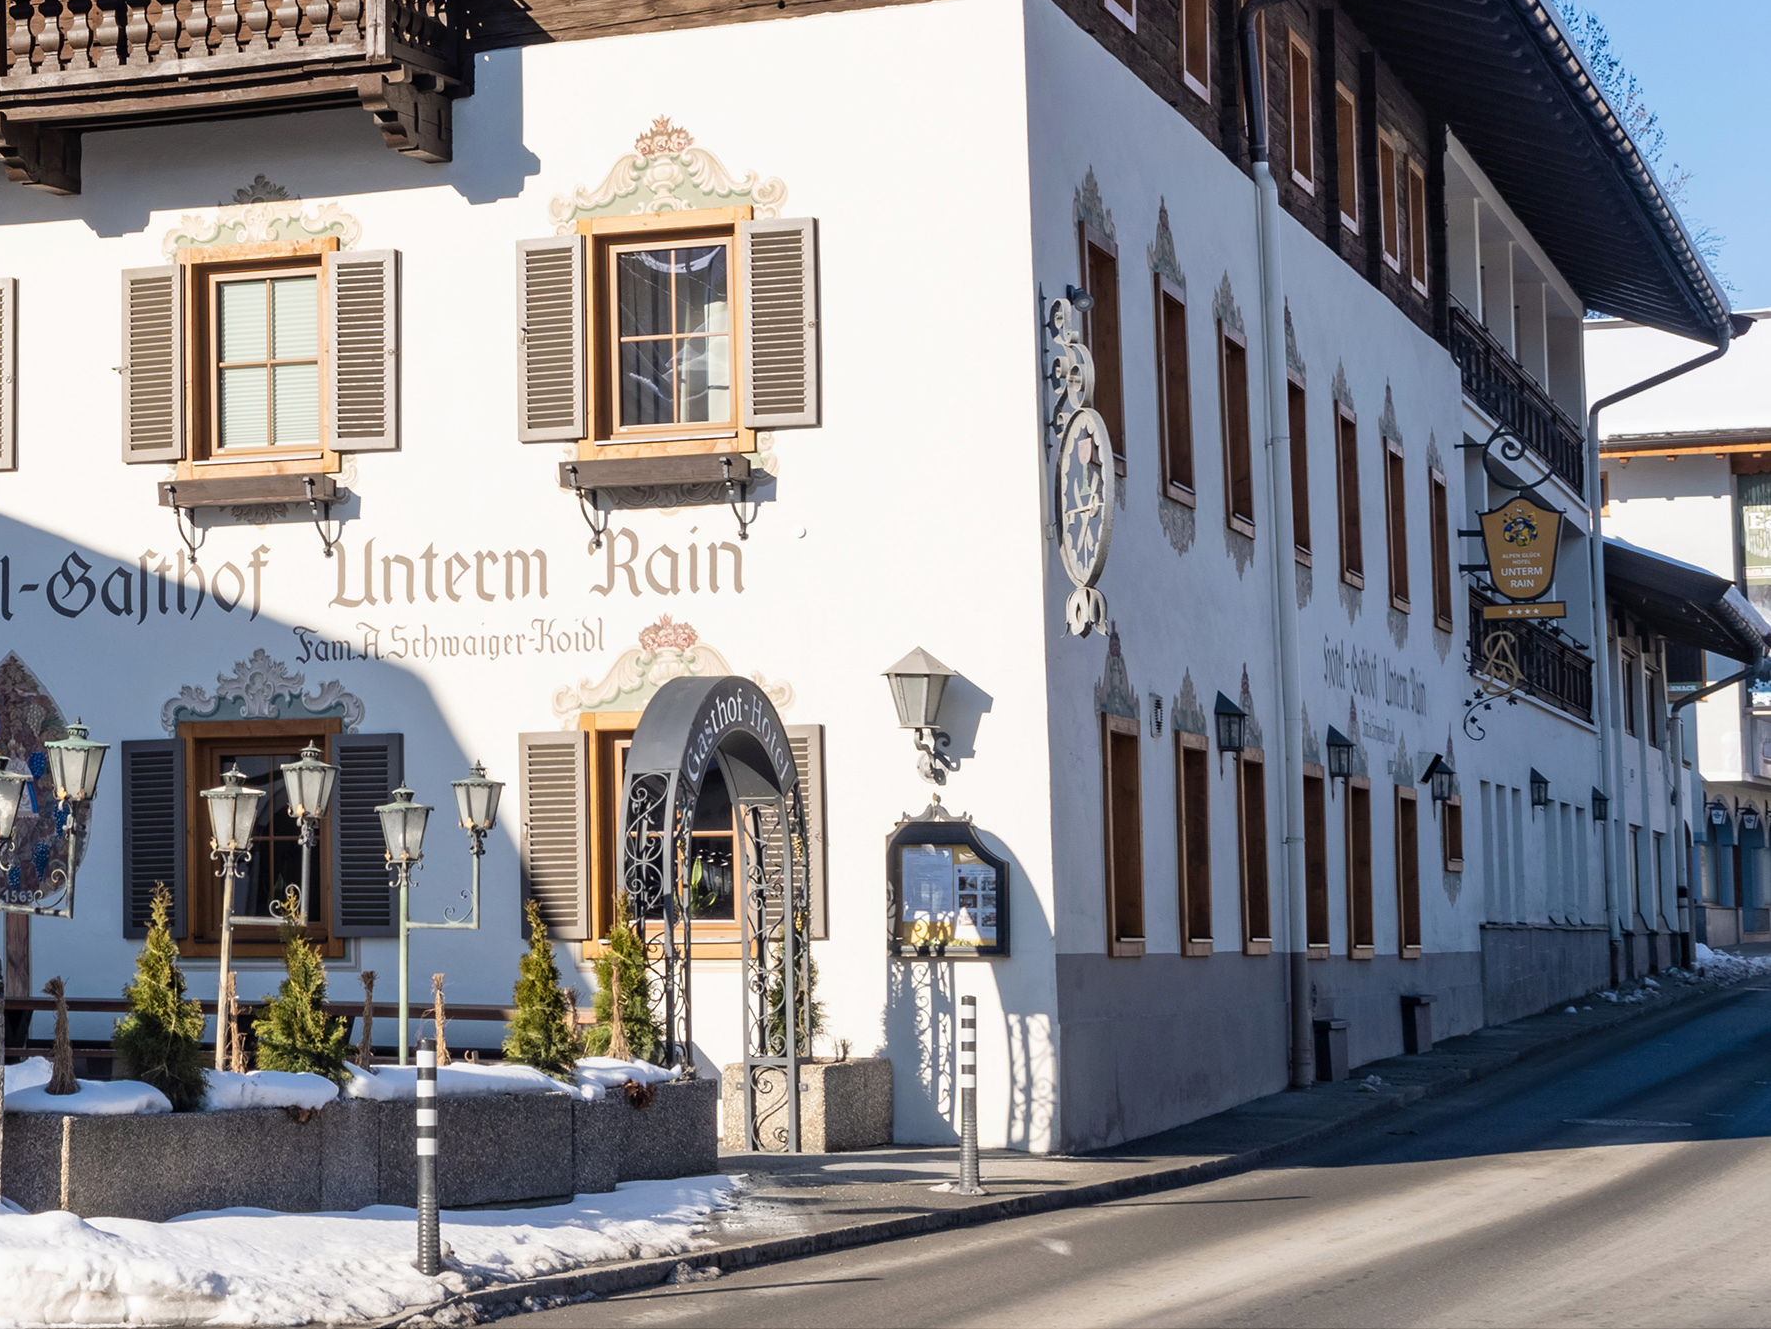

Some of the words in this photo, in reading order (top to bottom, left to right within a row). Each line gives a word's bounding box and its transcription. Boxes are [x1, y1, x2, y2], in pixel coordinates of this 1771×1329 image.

[328, 536, 549, 609] Unterm
[587, 525, 746, 598] Rain
[1500, 566, 1543, 576] UNTERM
[1510, 579, 1535, 588] RAIN
[3, 889, 34, 903] 1563
